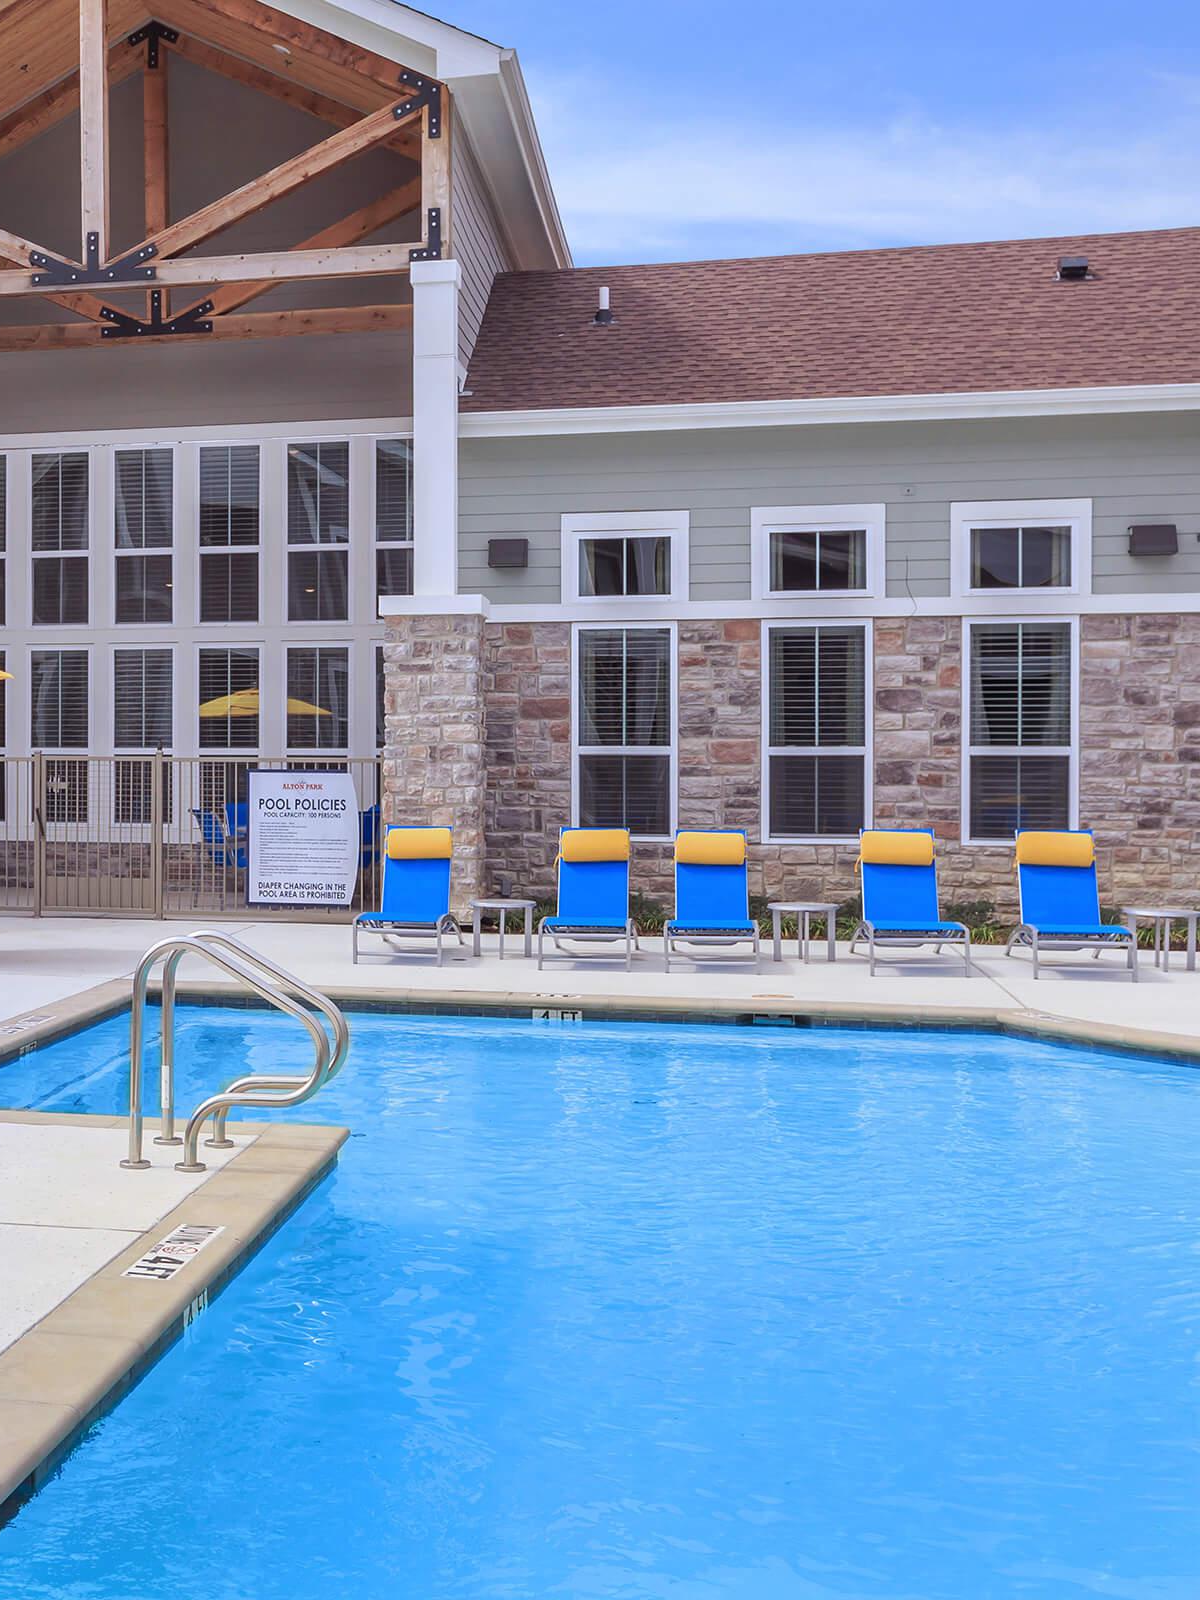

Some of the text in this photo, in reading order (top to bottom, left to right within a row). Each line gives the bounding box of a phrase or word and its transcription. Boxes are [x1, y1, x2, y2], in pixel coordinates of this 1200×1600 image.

[258, 798, 346, 811] POOL POLICIES
[283, 882, 324, 891] CHANGING
[334, 883, 346, 891] THE
[258, 890, 278, 898] POOL
[278, 890, 298, 898] AREA
[306, 891, 346, 900] PROHIBITED
